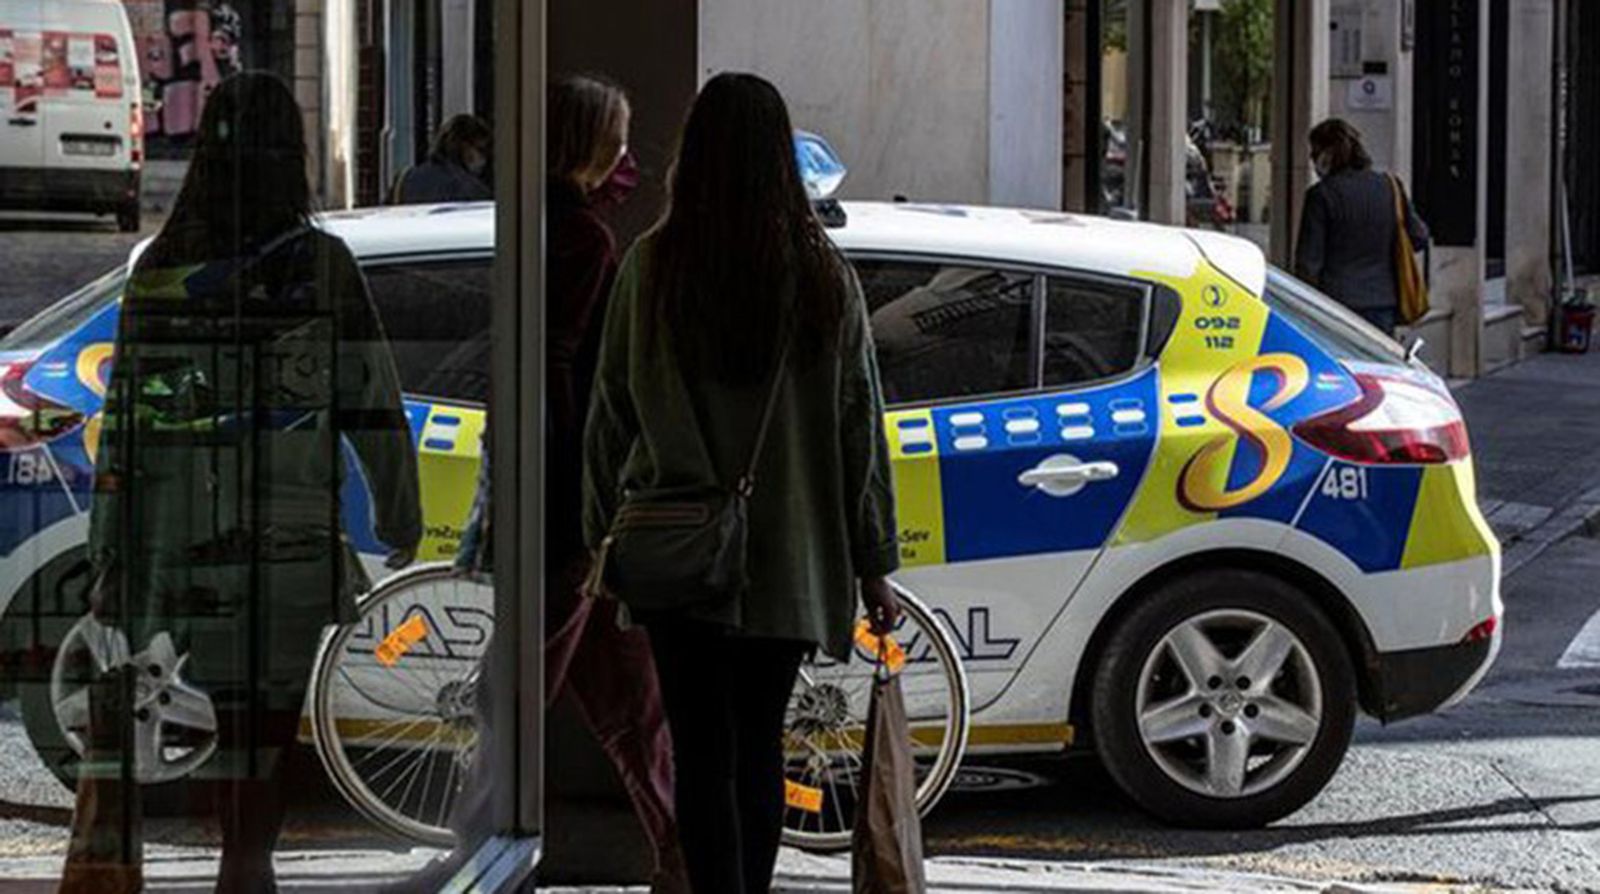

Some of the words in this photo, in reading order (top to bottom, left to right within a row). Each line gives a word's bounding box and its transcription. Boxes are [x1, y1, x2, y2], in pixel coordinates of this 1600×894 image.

[1195, 317, 1240, 330] 092
[1205, 336, 1234, 349] 112
[1321, 467, 1367, 499] 481
